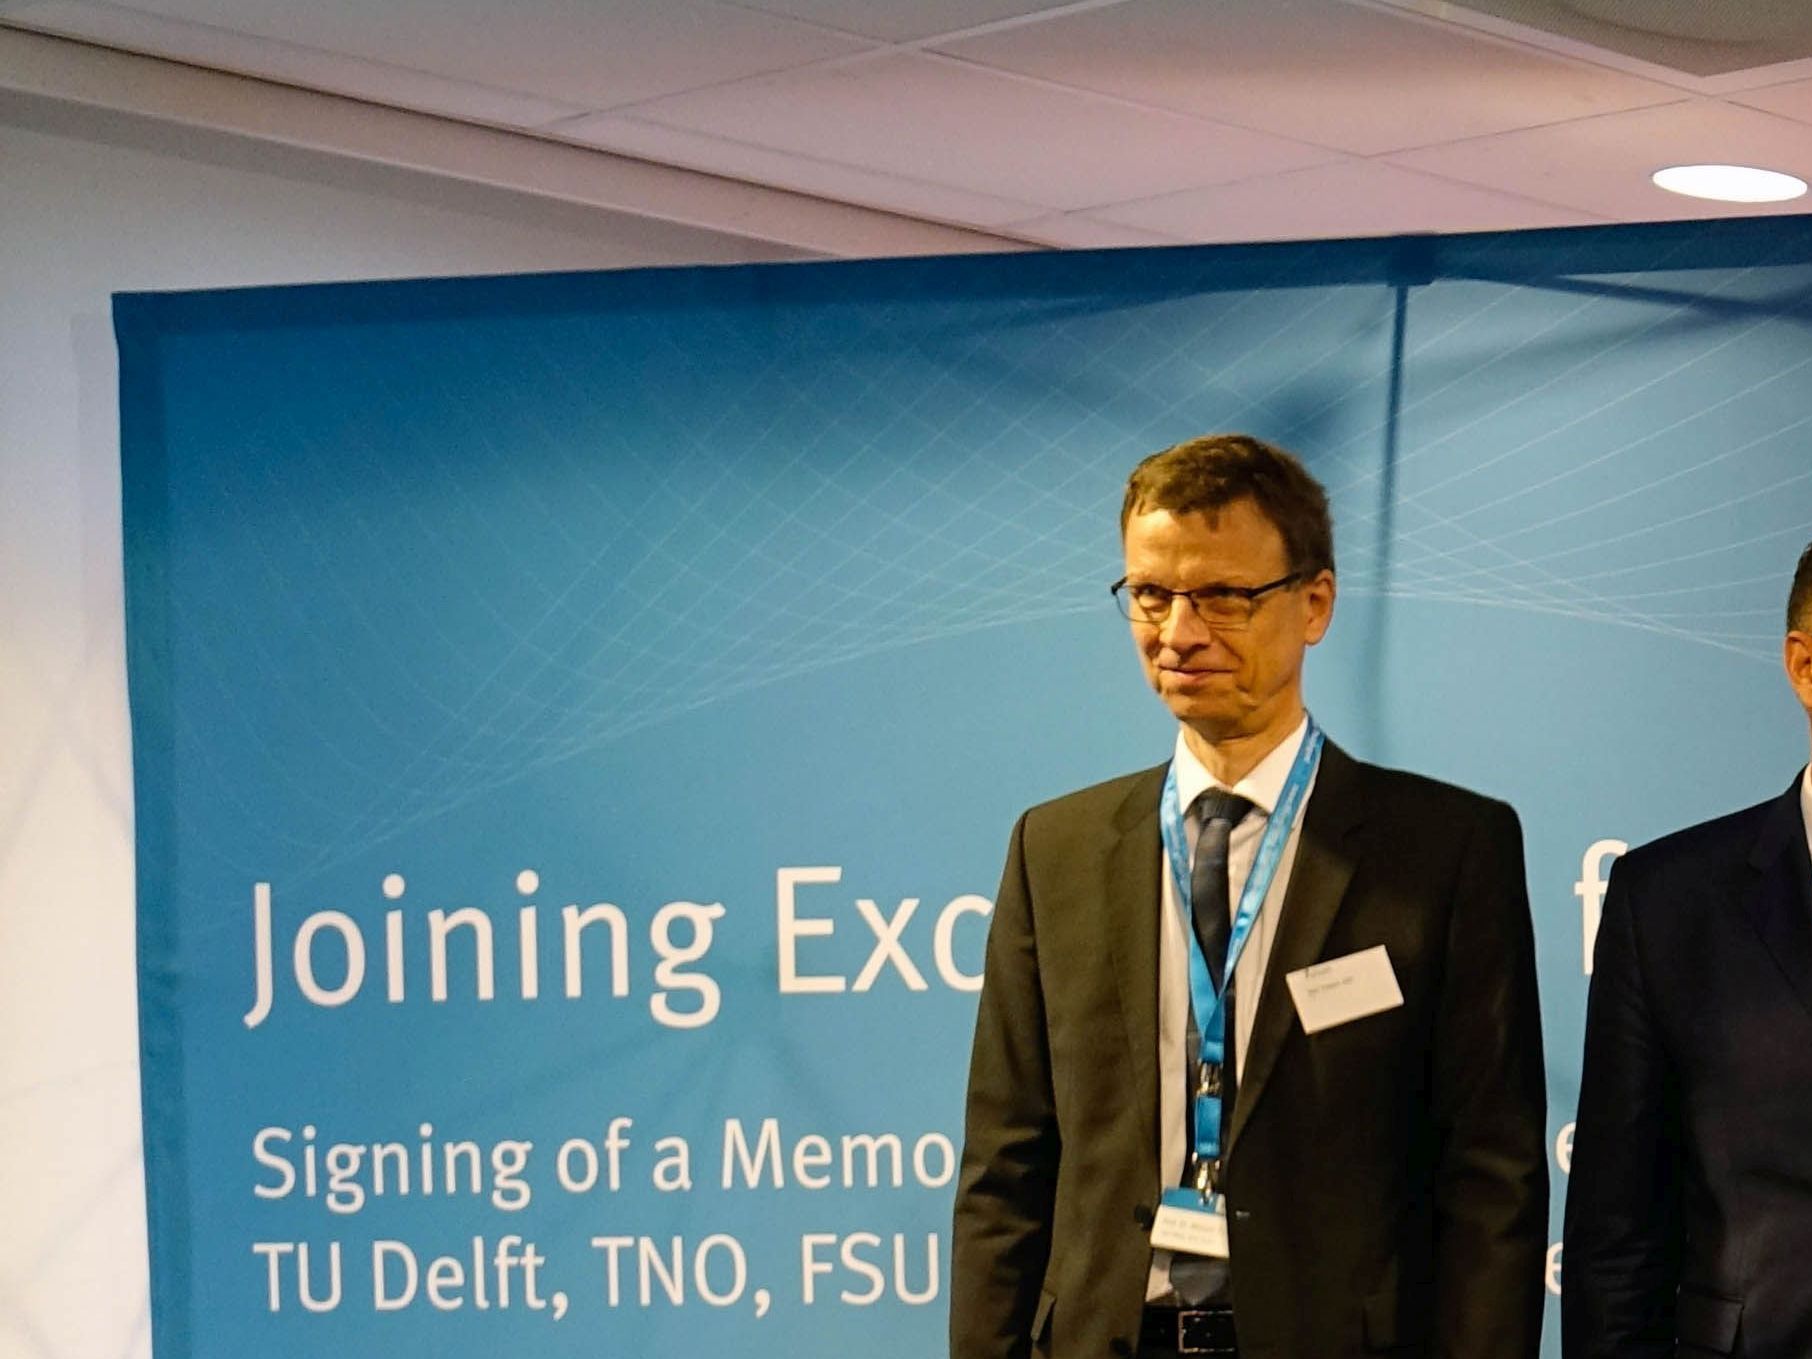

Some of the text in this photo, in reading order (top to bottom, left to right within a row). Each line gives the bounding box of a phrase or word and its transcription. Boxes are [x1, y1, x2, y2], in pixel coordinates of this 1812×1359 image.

[245, 869, 727, 1029] Joining
[253, 1123, 533, 1214] Signing
[556, 1117, 633, 1193] of
[653, 1136, 693, 1192] a
[252, 1232, 940, 1321] TU Delft, TNO, FSU
